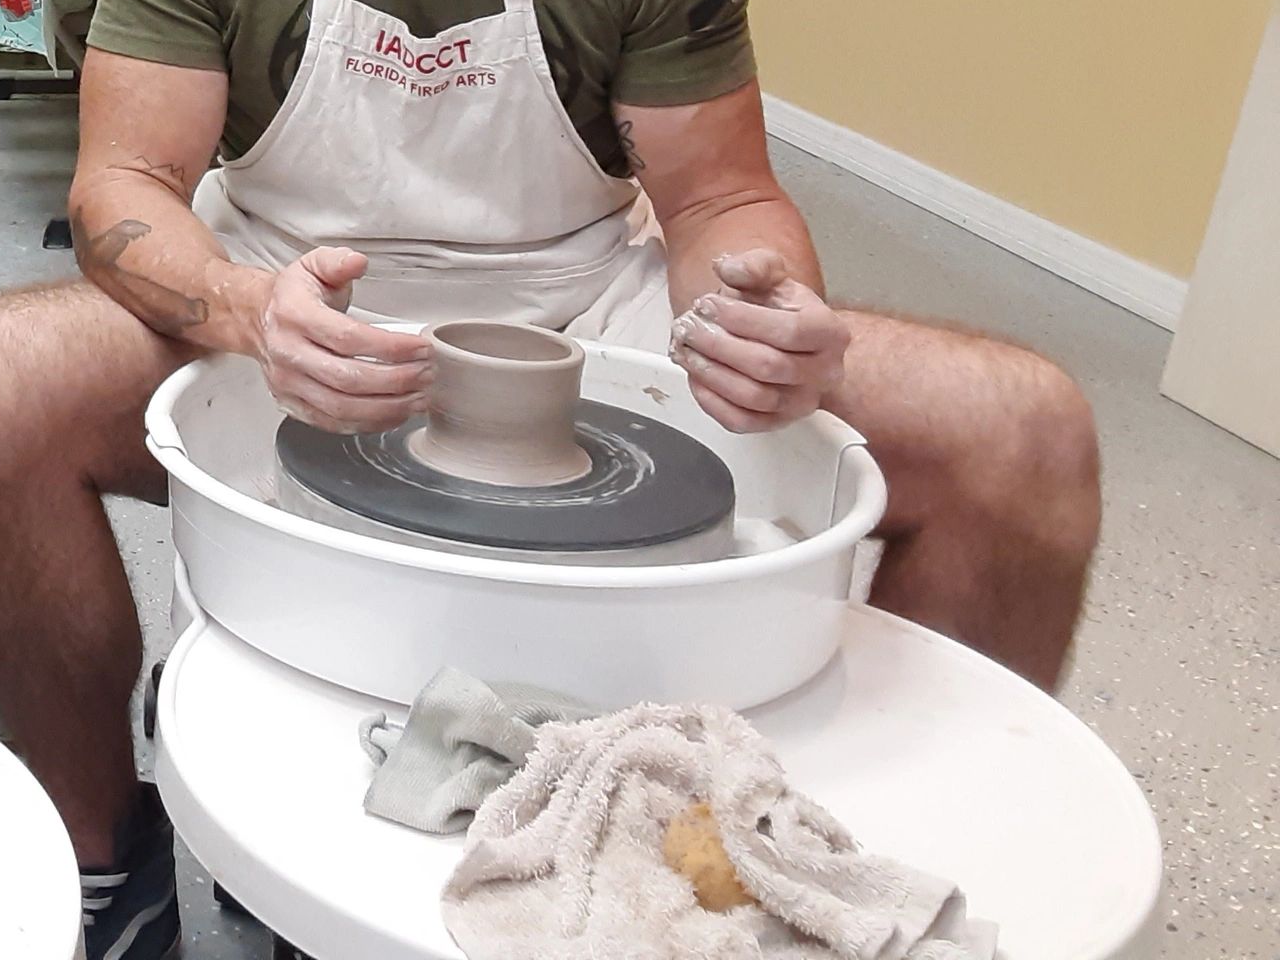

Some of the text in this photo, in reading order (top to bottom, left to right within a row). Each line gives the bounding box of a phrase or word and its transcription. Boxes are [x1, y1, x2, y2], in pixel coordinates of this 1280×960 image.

[346, 57, 497, 97] FLORIDA FIRED ARTS
